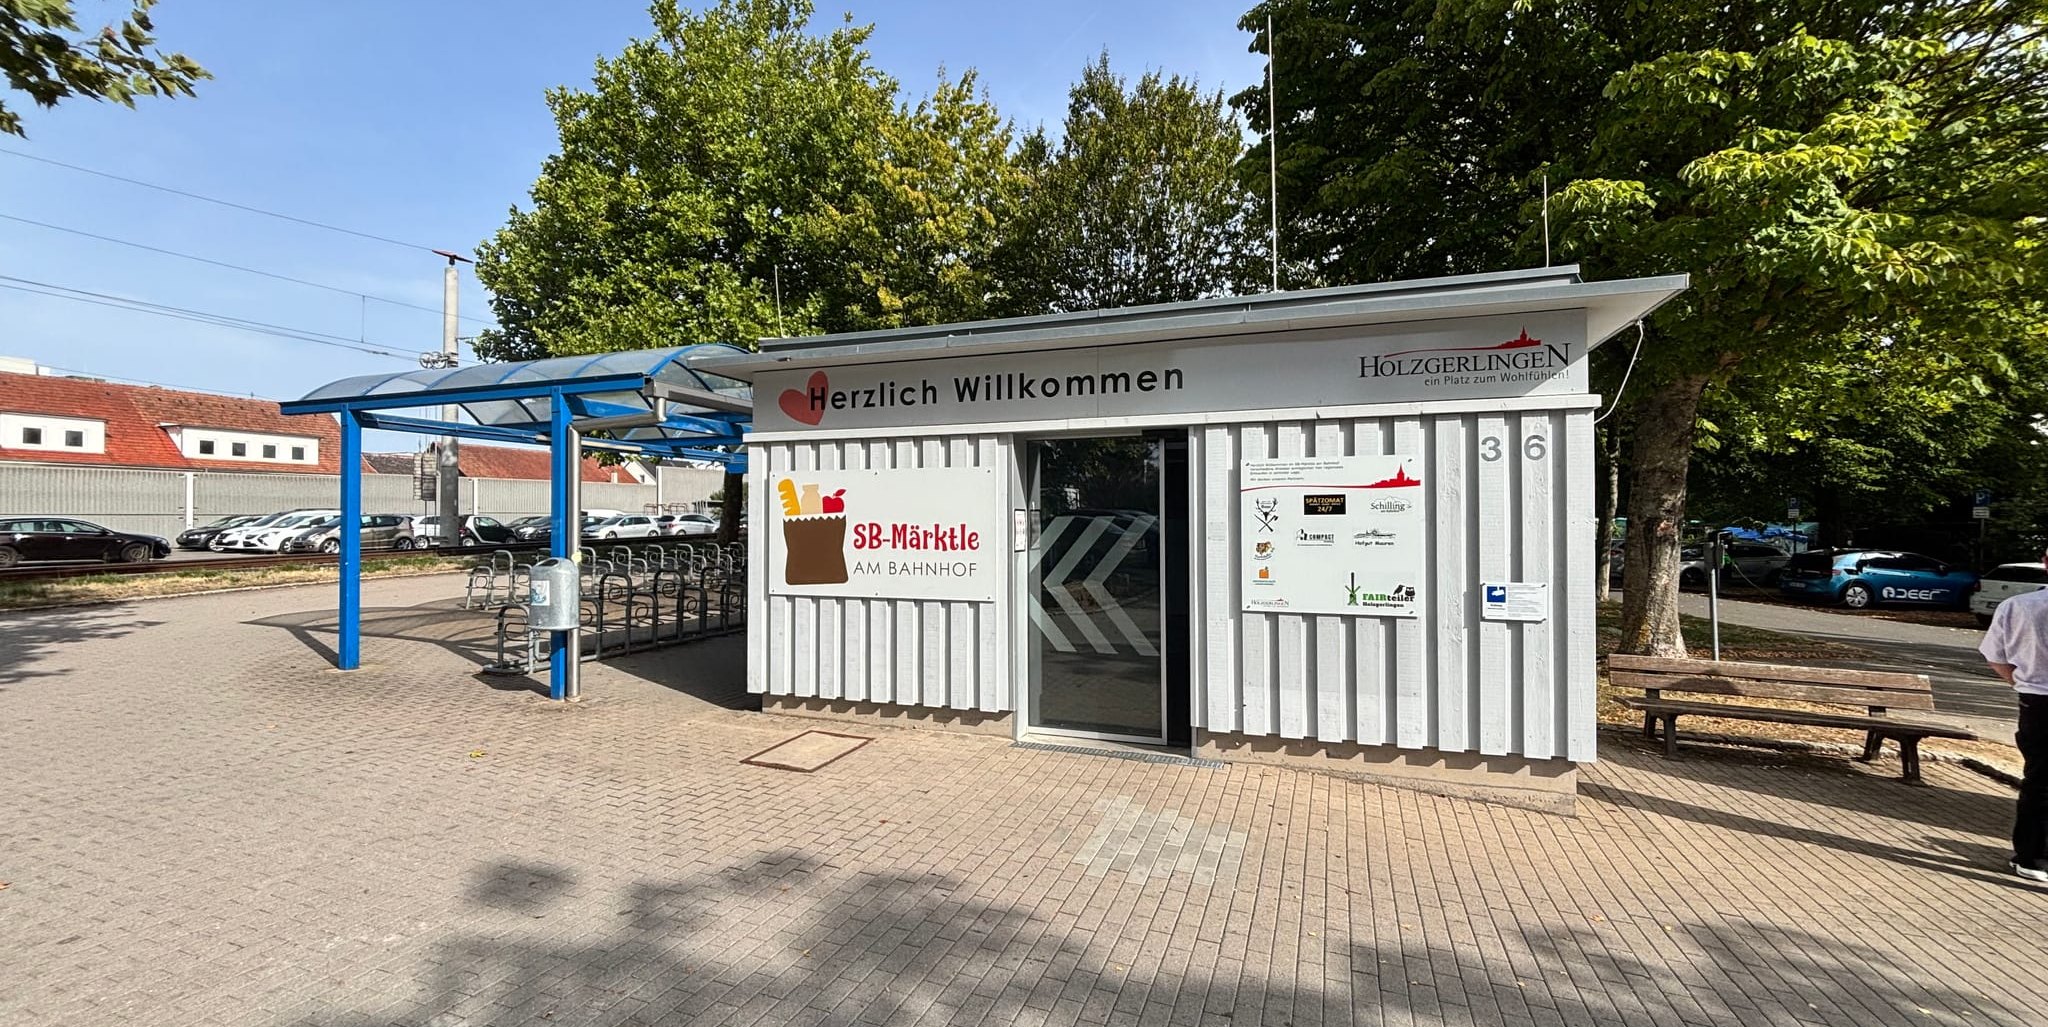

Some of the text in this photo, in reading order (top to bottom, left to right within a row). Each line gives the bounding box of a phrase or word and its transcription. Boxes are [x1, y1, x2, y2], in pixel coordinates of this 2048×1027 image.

[1424, 369, 1570, 386] ein Platz zum Wohlfühlen!
[810, 368, 1184, 411] Herzlich Willkommen
[1317, 505, 1333, 513] 24/7
[1370, 501, 1406, 512] Schilling
[853, 523, 980, 551] SB-Märktle
[853, 561, 977, 577] AM BAHNHOF
